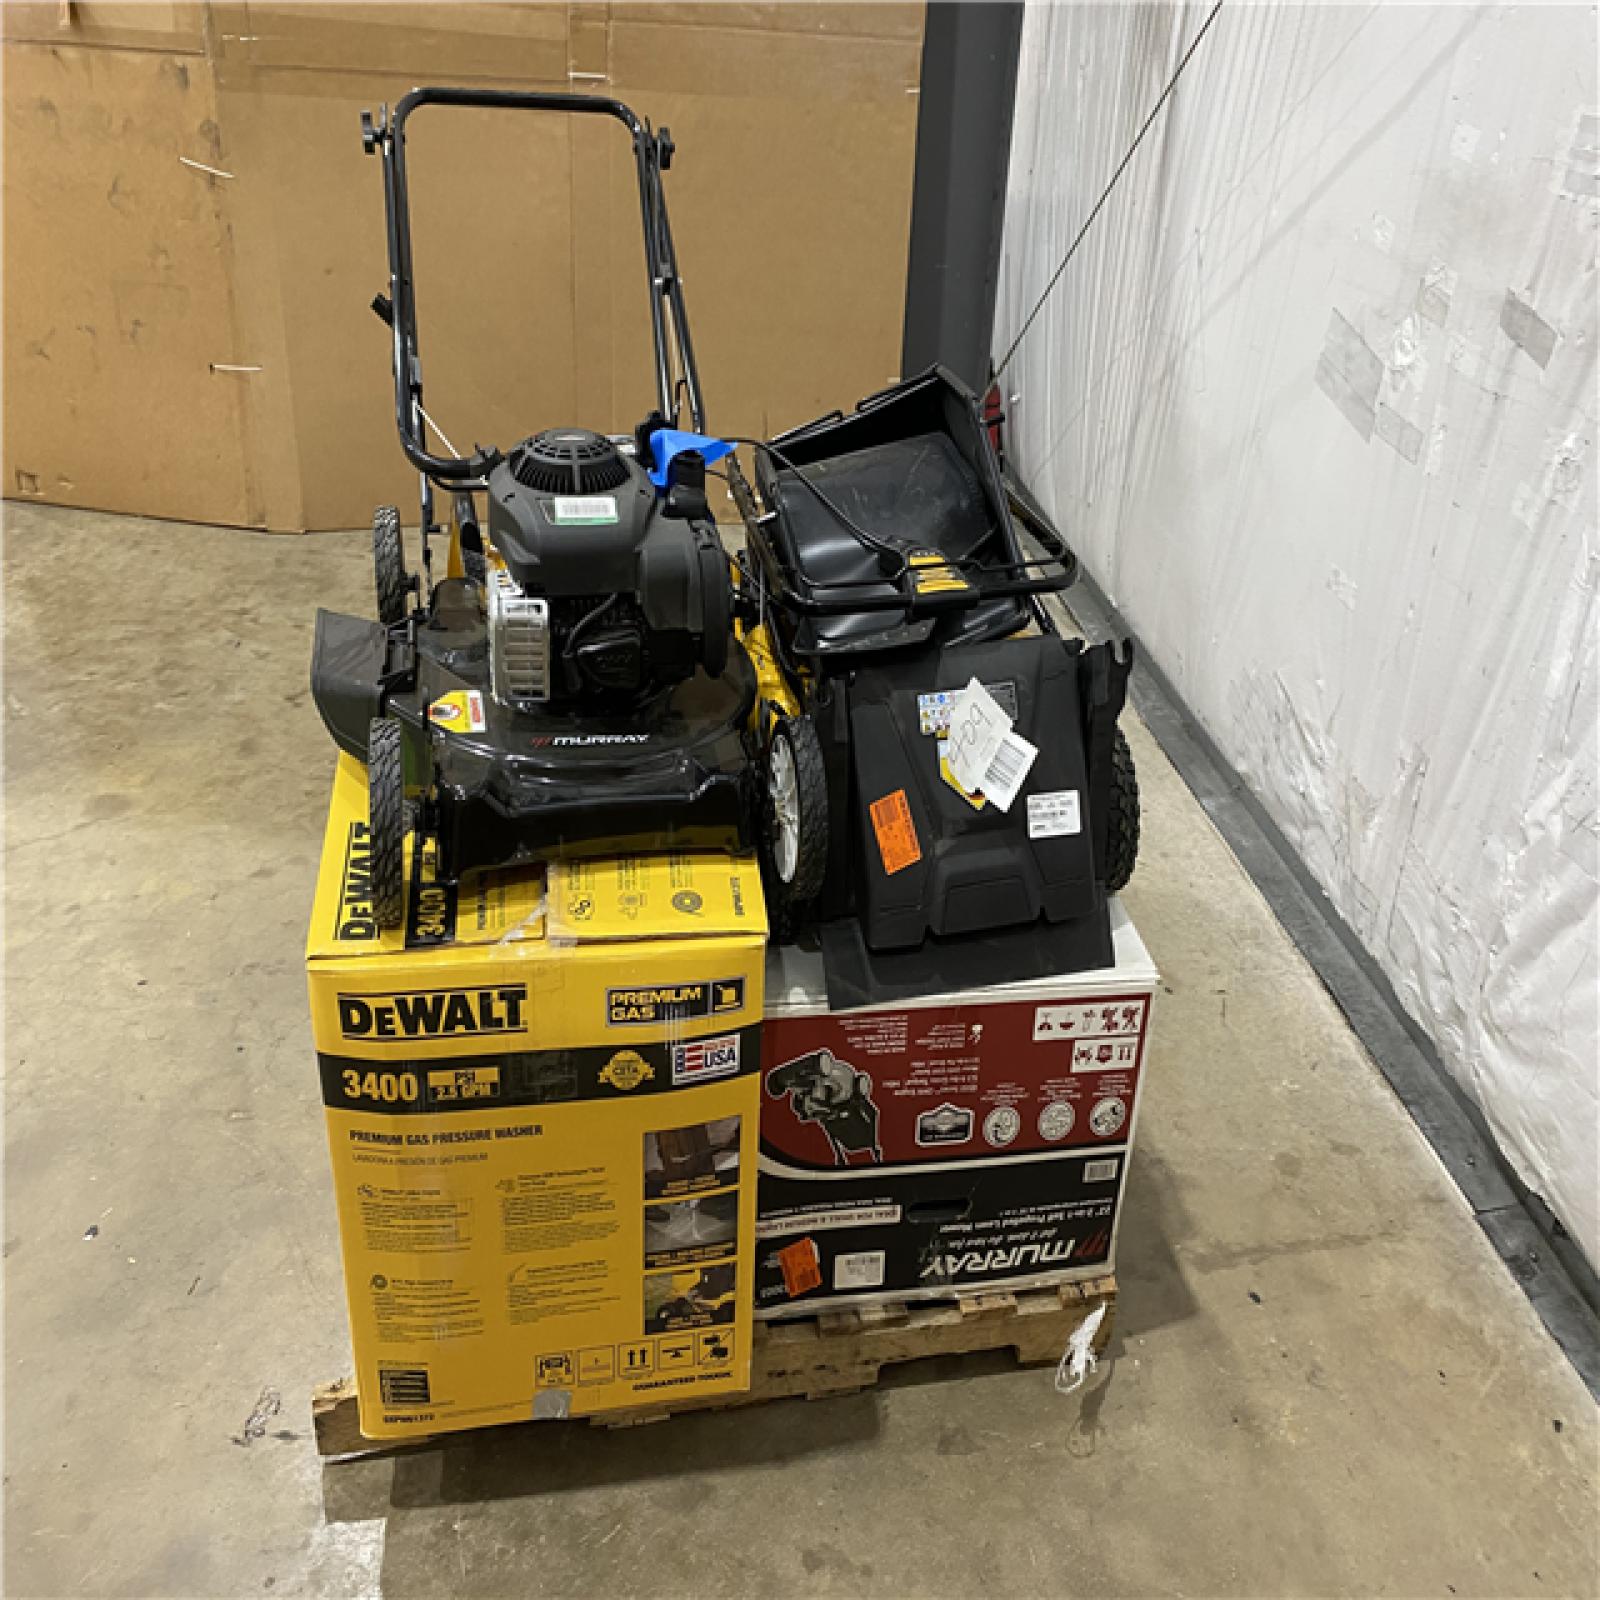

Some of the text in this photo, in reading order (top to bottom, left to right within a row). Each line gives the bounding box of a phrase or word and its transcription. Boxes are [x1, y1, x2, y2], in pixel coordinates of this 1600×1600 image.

[552, 733, 650, 746] MURRAY
[415, 888, 446, 937] 3400
[610, 986, 702, 1006] PREMIUM
[611, 1005, 656, 1021] GAS
[341, 1068, 419, 1102] 3400
[349, 1124, 543, 1146] PREMIUM GAS PRESSURE WASHER
[920, 1238, 1077, 1280] MURRAY
